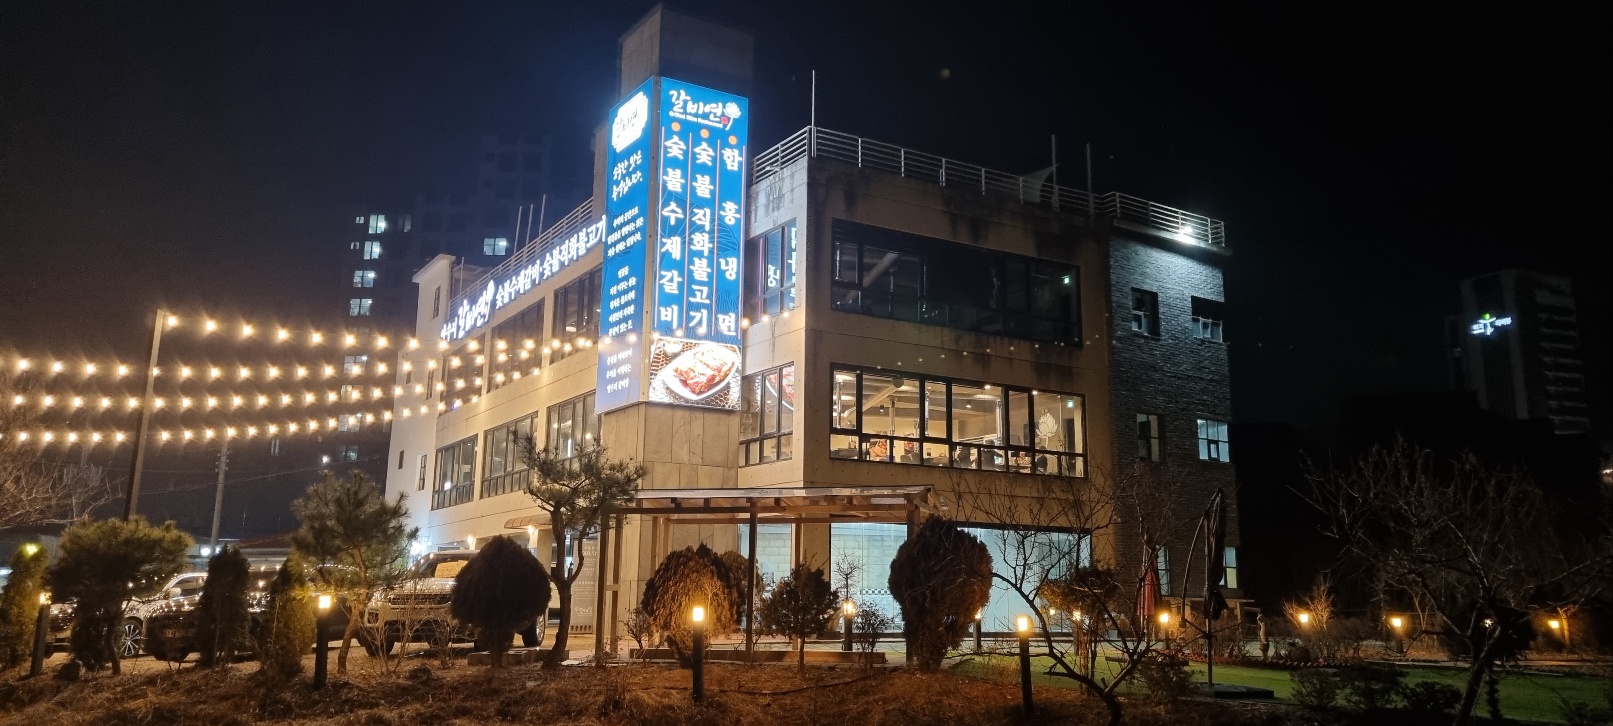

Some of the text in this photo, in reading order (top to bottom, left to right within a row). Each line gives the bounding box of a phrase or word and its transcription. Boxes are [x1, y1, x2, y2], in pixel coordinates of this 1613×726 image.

[669, 90, 723, 121] 갈비연
[458, 290, 488, 339] 갈비연
[659, 135, 687, 330] 숯불수제갈비
[688, 142, 715, 334] 숯불직화불고기
[717, 148, 743, 336] 함흥냉면
